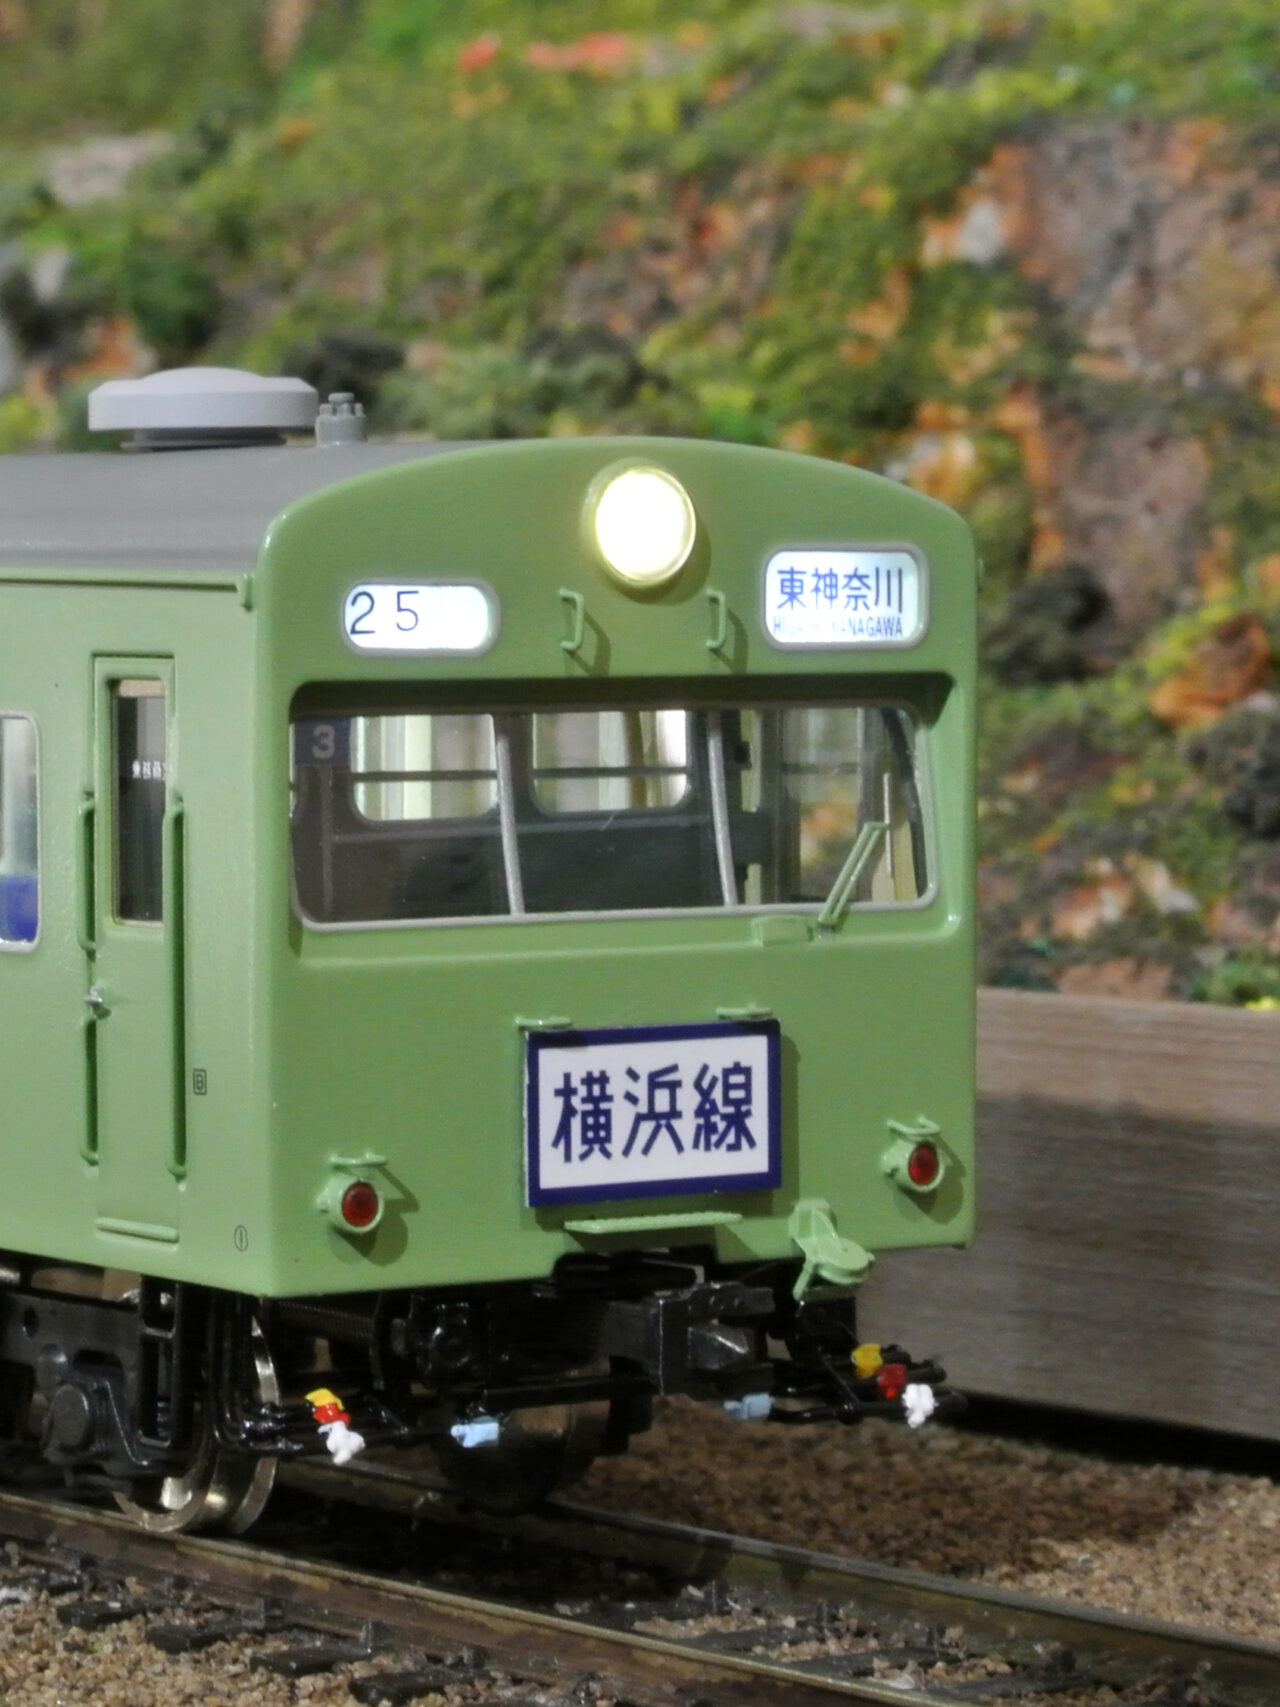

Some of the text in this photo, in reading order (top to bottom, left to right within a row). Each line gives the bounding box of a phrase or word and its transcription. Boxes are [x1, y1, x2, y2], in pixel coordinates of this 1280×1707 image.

[777, 566, 903, 613] 東神奈川
[312, 724, 335, 759] 3
[551, 1061, 757, 1163] 横浜線
